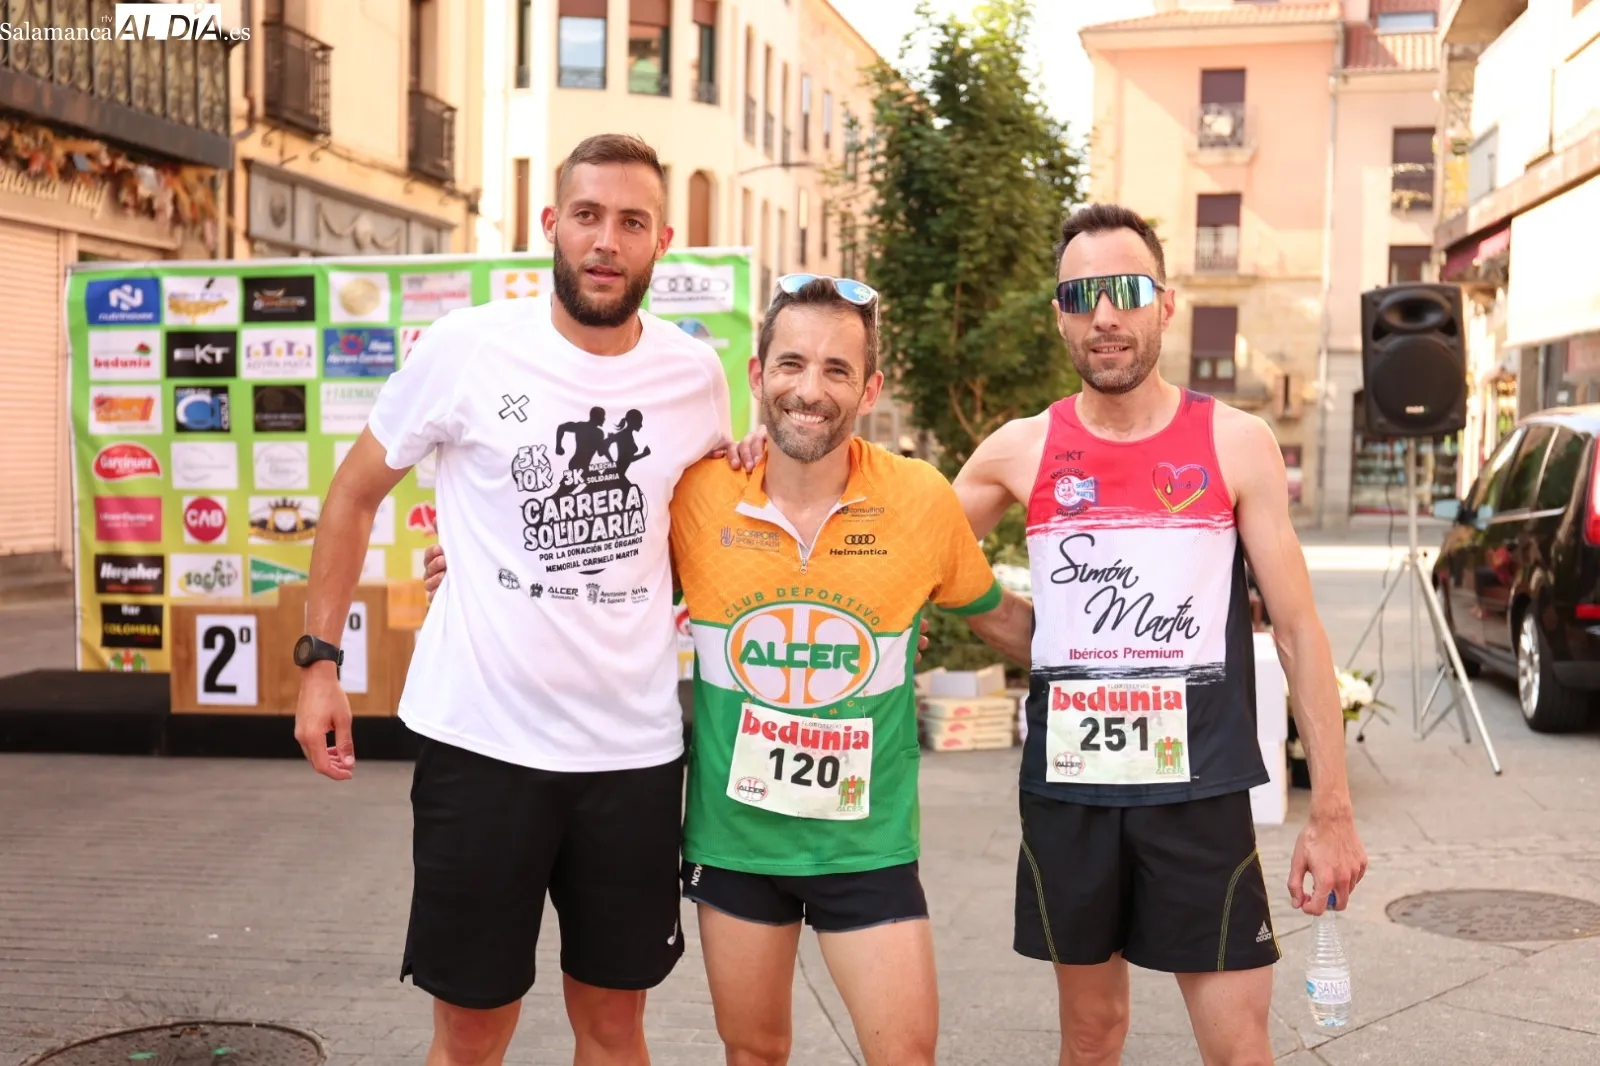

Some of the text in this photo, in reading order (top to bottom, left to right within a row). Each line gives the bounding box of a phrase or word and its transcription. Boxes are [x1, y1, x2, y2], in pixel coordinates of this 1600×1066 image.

[94, 357, 151, 369] bedunia
[515, 444, 549, 470] 5K
[588, 462, 617, 472] MARCHA
[513, 467, 553, 492] 10K
[562, 468, 585, 487] 3K
[586, 472, 620, 484] SOLIDARIA
[186, 508, 224, 528] CAB
[522, 484, 644, 526] CARRERA
[523, 509, 647, 551] SOLIDARIA
[539, 536, 643, 562] POR LA DONACIÓN DE ÓRGANOS
[829, 548, 888, 556] Helmántica
[1050, 532, 1139, 589] Simón
[545, 560, 581, 573] MEMORIAL
[582, 554, 615, 566] CARMELO
[547, 586, 579, 597] ALCER
[724, 585, 881, 627] CLUB DEPORTIVO
[1084, 585, 1200, 643] Martín
[738, 639, 861, 675] ALCER
[1069, 647, 1184, 660] Ibéricos Premium
[1051, 685, 1183, 712] bedunia
[741, 708, 870, 751] bedunia
[1079, 716, 1149, 752] 251
[769, 747, 840, 789] 120
[737, 783, 766, 797] ALCER
